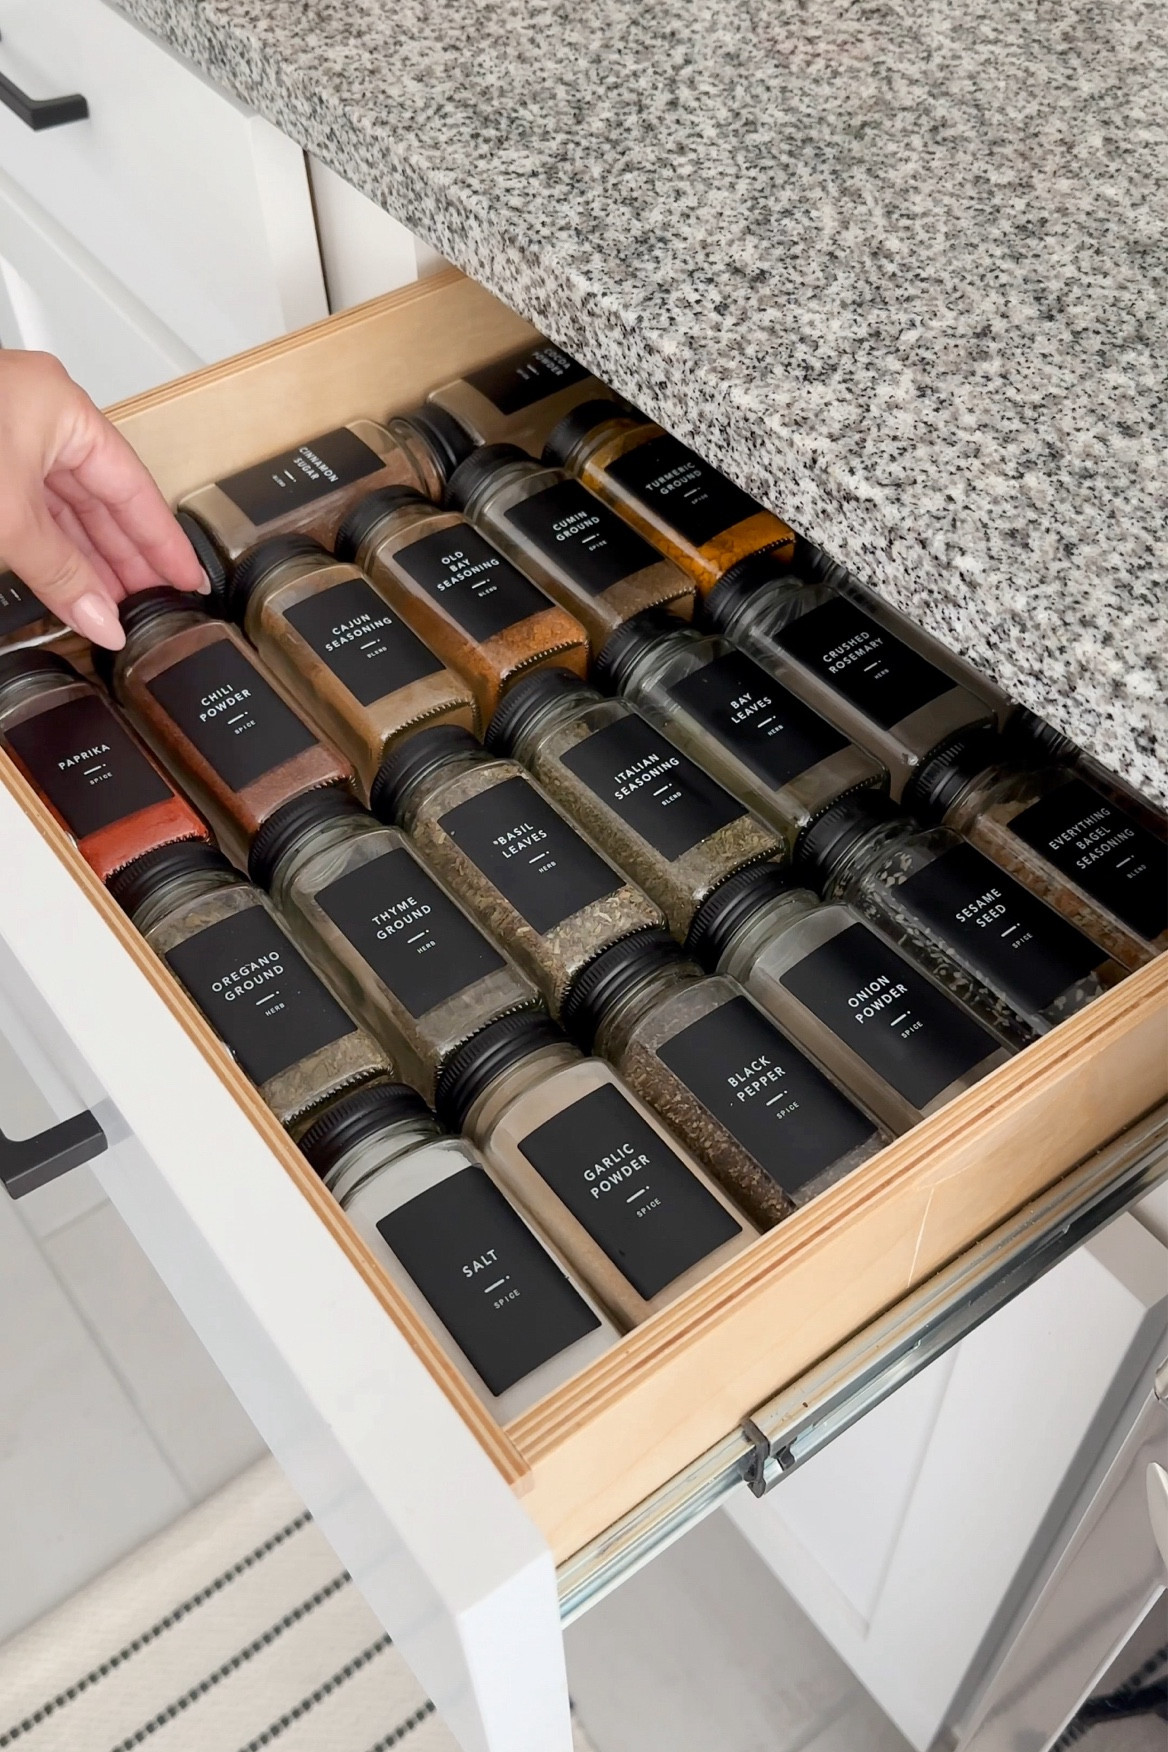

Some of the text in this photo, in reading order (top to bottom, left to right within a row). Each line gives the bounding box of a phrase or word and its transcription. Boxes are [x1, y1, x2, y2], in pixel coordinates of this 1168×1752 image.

[294, 458, 320, 480] SUGAR
[299, 446, 339, 482] CINNAMON
[646, 462, 696, 491] TURMERIC
[660, 470, 702, 495] GROUND
[553, 511, 588, 531] CUMIN
[556, 516, 600, 542] GROUND
[442, 551, 464, 565] OLD
[450, 559, 471, 573] BAY
[437, 559, 500, 592] SEASONING
[326, 617, 393, 651] SEASONING
[332, 614, 371, 635] CAJUN
[823, 631, 869, 663] CRUSHED
[829, 637, 883, 674] ROSEMARY
[199, 689, 252, 722] POWDER
[201, 684, 234, 706] CHILI
[731, 692, 752, 710] BAY
[731, 697, 771, 724] LEAVES
[234, 719, 256, 735] SPICE
[58, 744, 110, 770] PAPRIKA
[615, 753, 660, 783] ITALIAN
[90, 772, 113, 785] SPICE
[614, 757, 680, 800] SEASONING
[497, 823, 534, 846] BASIL
[1049, 808, 1111, 850] EVERYTHING
[1076, 826, 1111, 850] BAGEL
[502, 829, 548, 859] LEAVES
[1076, 829, 1135, 870] SEASONING
[539, 861, 557, 873] HERB
[371, 896, 418, 925] THYME
[956, 888, 1002, 923] SESAME
[976, 904, 1006, 928] SEED
[377, 905, 431, 940] GROUND
[417, 940, 436, 954] HERB
[1012, 932, 1033, 949] SPICE
[212, 952, 280, 992] OREGANO
[225, 965, 284, 1001] GROUND
[848, 975, 890, 1008] ONION
[855, 984, 908, 1024] POWDER
[265, 1002, 285, 1017] HERB
[901, 1020, 924, 1039] SPICE
[728, 1056, 771, 1088] BLACK
[737, 1066, 786, 1102] PEPPER
[777, 1101, 800, 1120] SPICE
[584, 1143, 634, 1181] GARLIC
[590, 1154, 651, 1199] POWDER
[637, 1198, 662, 1218] SPICE
[462, 1249, 498, 1278] SALT
[493, 1289, 521, 1309] SPICE
